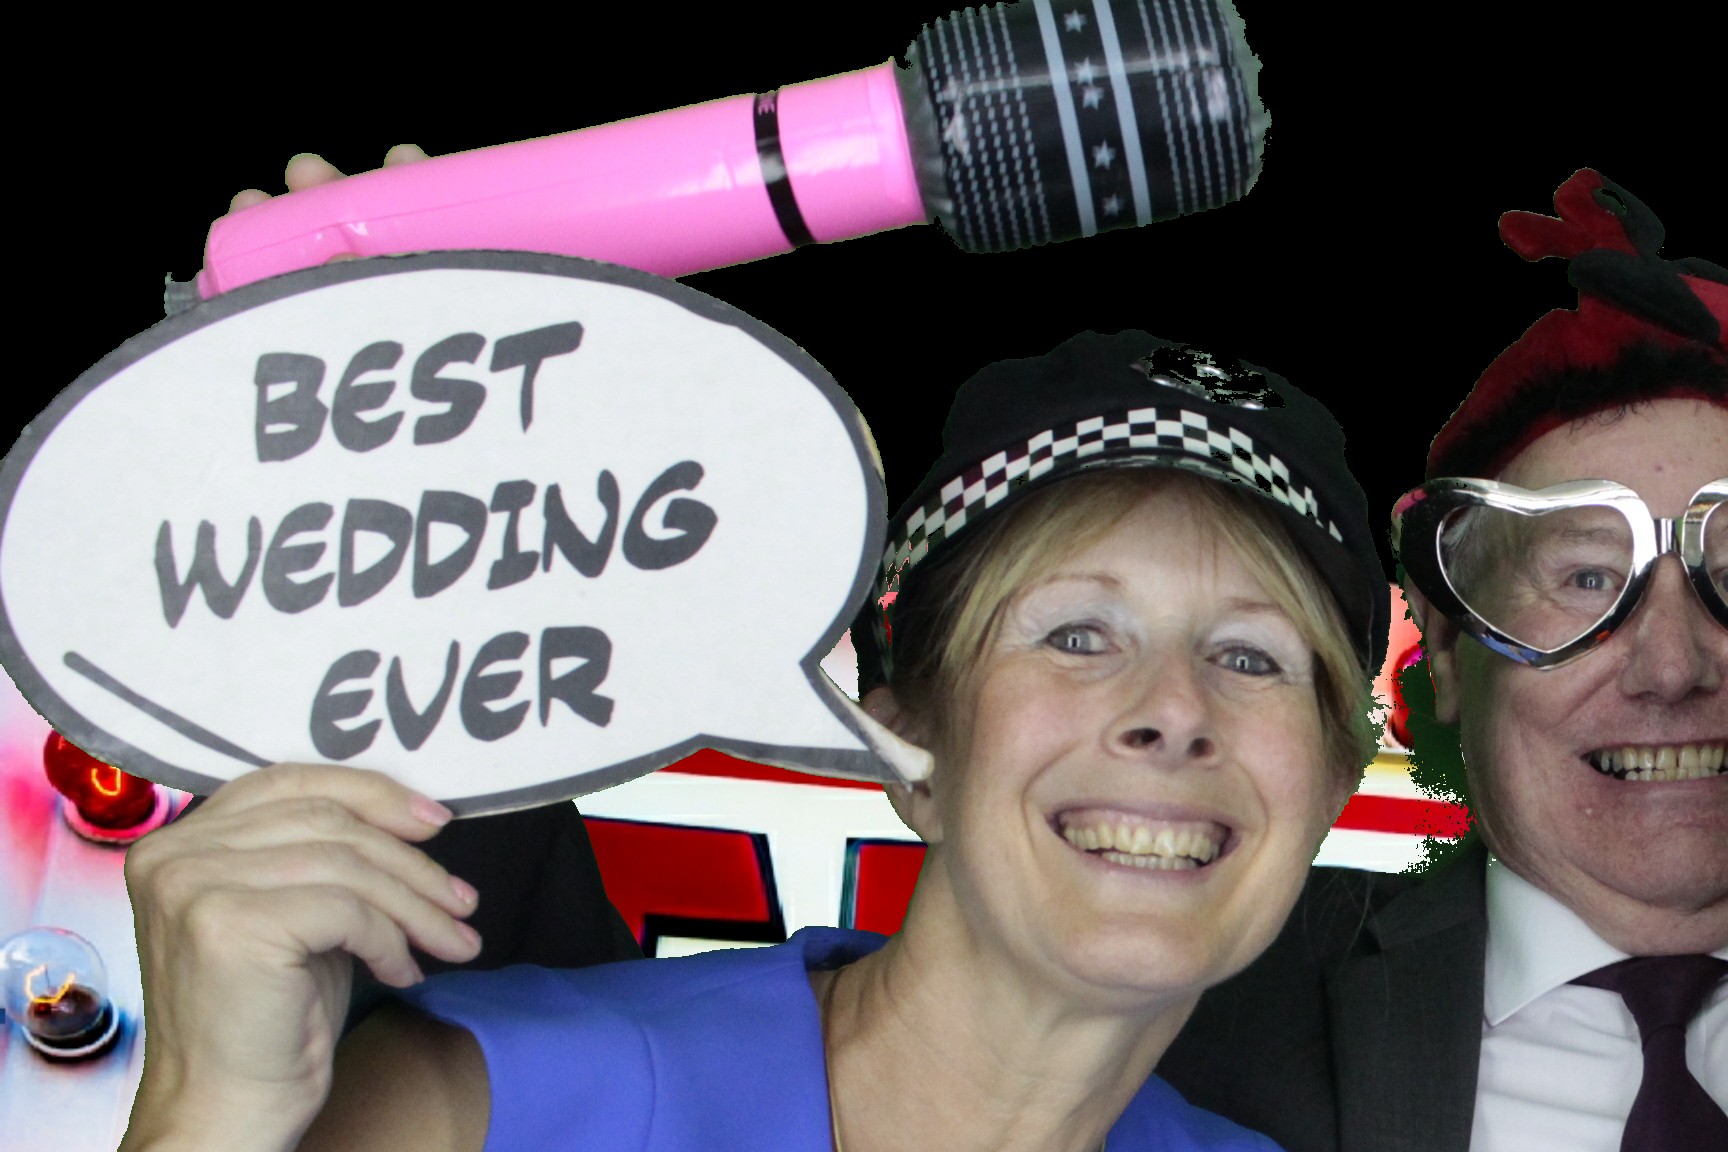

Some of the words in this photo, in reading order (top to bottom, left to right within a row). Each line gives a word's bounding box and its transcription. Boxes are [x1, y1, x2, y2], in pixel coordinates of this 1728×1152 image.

[255, 322, 583, 461] BEST
[155, 461, 719, 627] WEDDING
[310, 628, 614, 759] EVER
